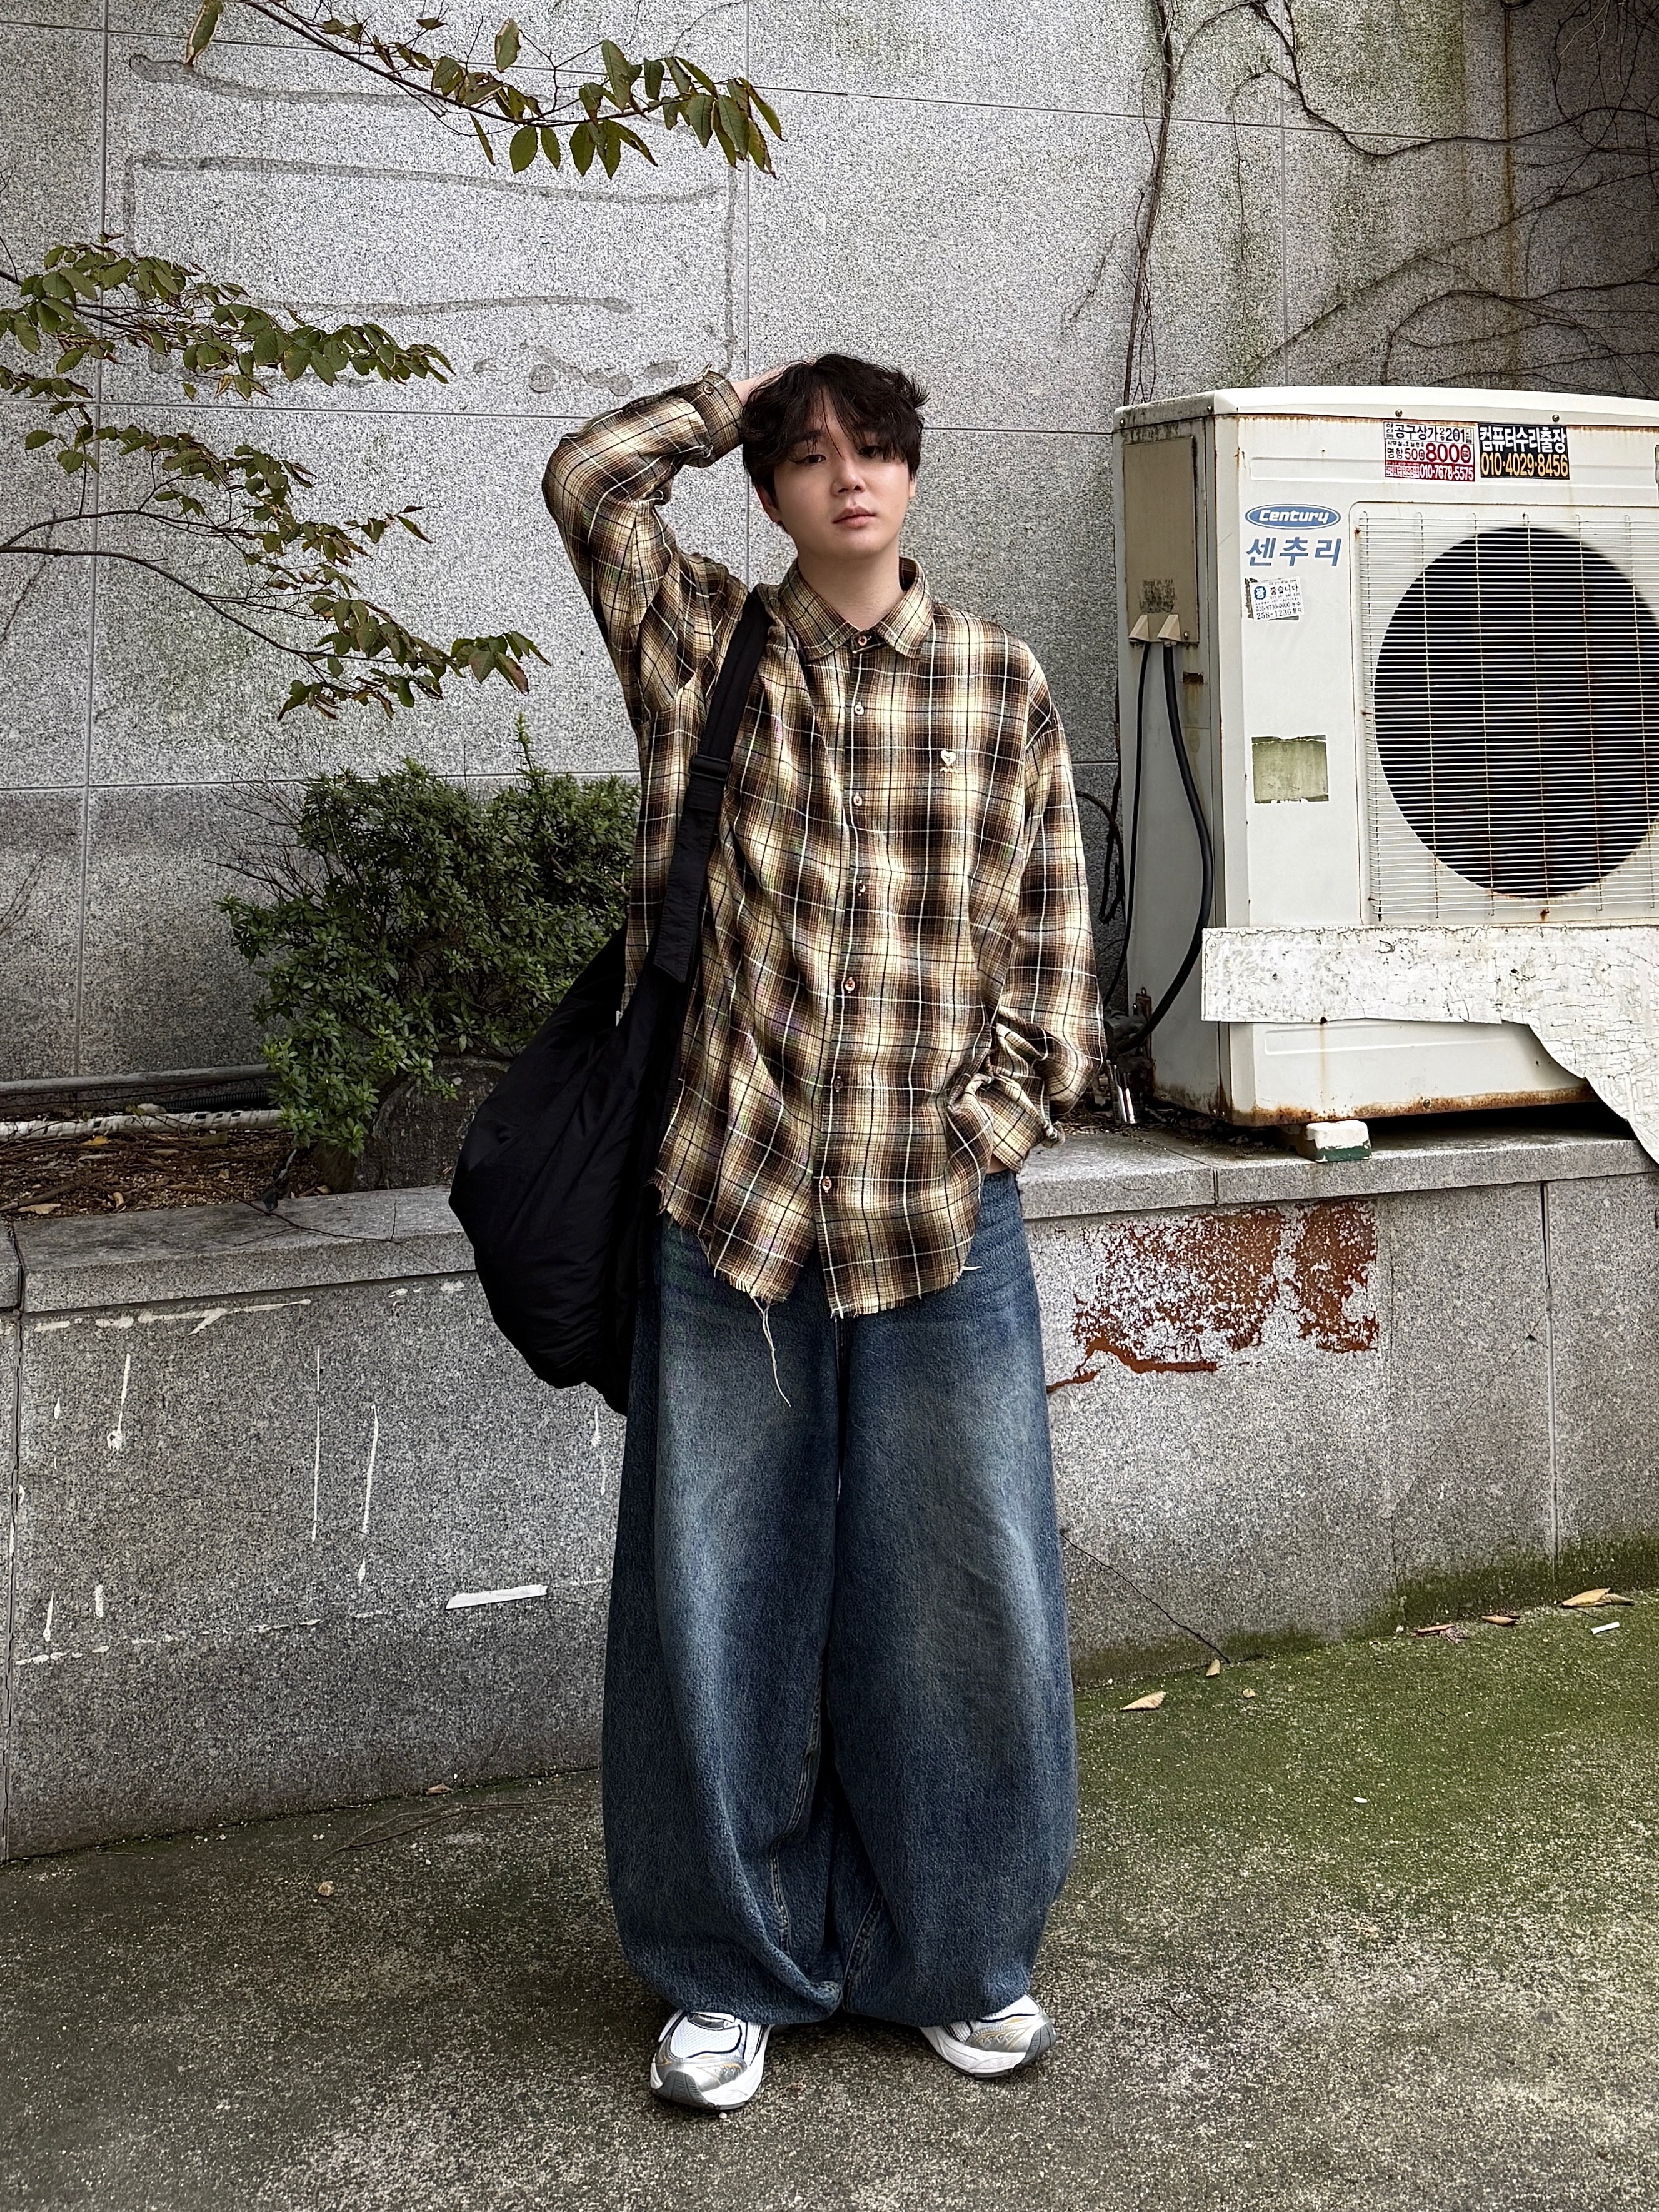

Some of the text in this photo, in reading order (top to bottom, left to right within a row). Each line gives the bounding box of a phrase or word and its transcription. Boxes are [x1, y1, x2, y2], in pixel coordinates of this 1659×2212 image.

[1395, 425, 1438, 442] 공구상가
[1479, 426, 1566, 453] 컴퓨터수리출장
[1420, 463, 1474, 481] 010-7678-5575
[1259, 510, 1329, 524] Century
[1246, 537, 1342, 566] 센추리
